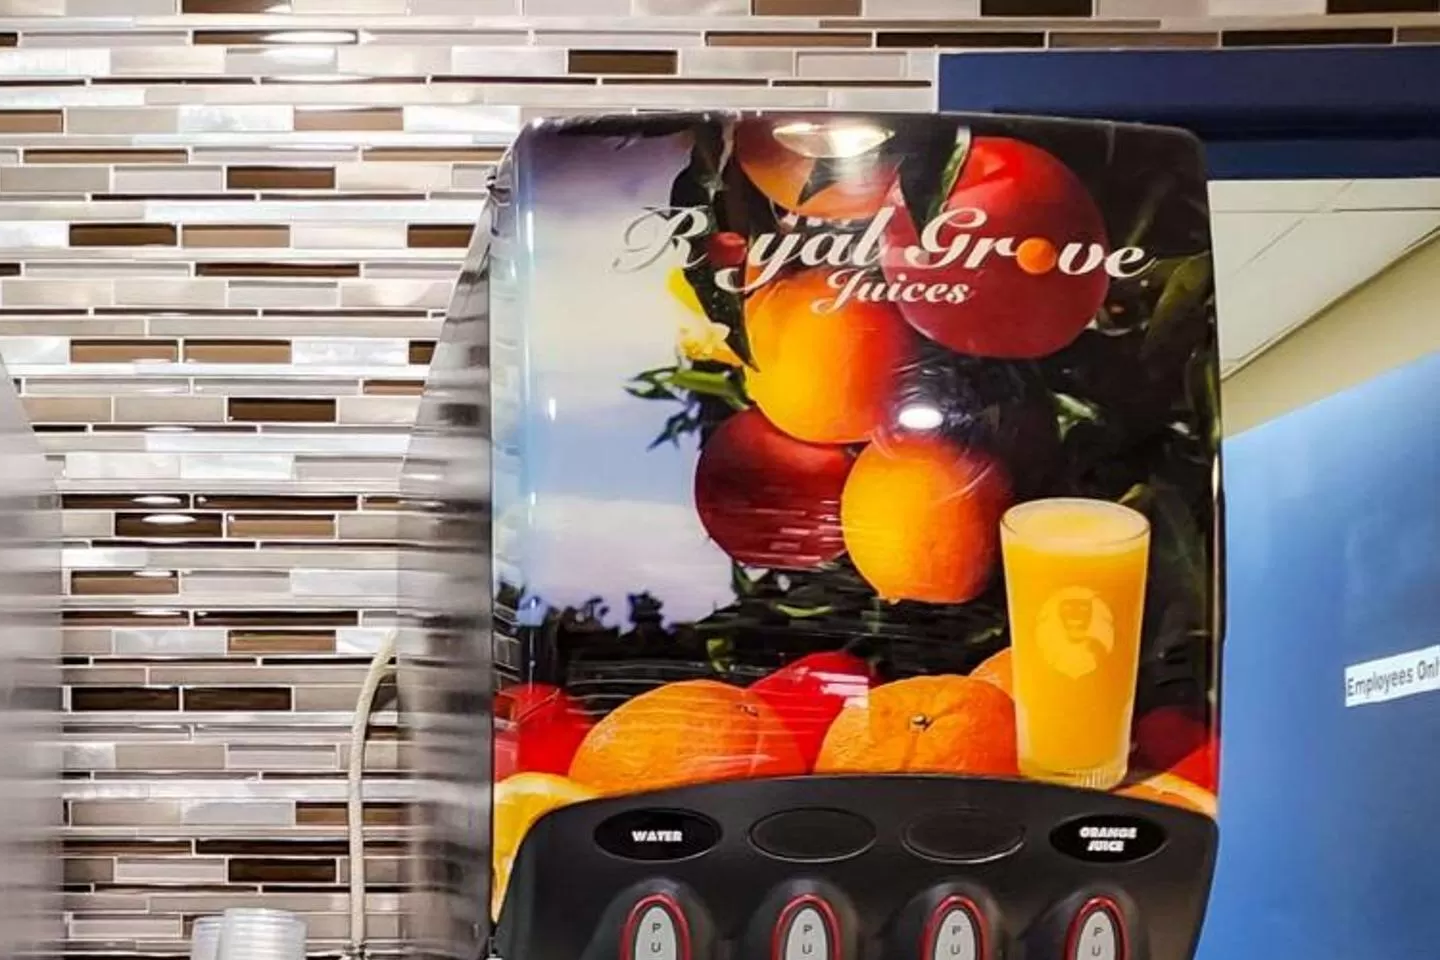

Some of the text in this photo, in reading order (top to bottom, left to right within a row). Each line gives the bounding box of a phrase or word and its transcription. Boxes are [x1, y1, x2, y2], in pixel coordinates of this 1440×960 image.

[903, 205, 1158, 279] Grove
[811, 267, 973, 315] Juices
[1347, 656, 1440, 699] Employees Onl
[631, 830, 683, 842] WATER
[1079, 826, 1138, 839] ORANGE
[1087, 840, 1125, 852] JUICE
